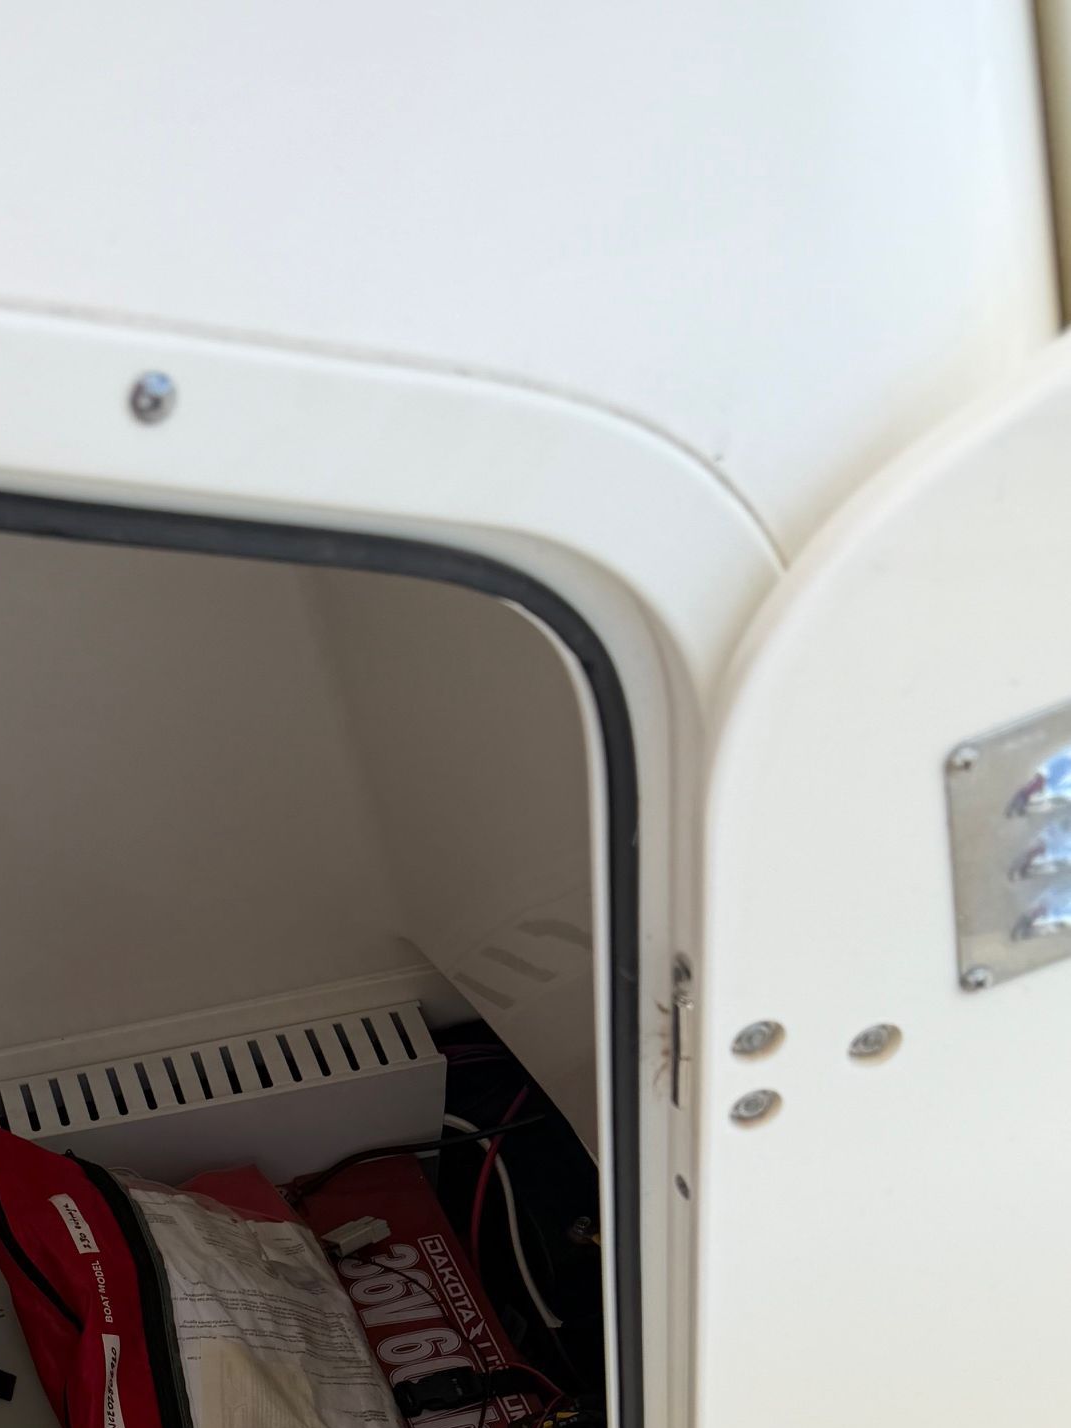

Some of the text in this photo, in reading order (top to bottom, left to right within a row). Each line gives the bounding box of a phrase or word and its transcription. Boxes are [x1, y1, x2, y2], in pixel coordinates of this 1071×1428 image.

[91, 1260, 114, 1324] BOAT MODEL
[338, 1243, 449, 1328] 36V
[423, 1238, 476, 1323] DAKOTA
